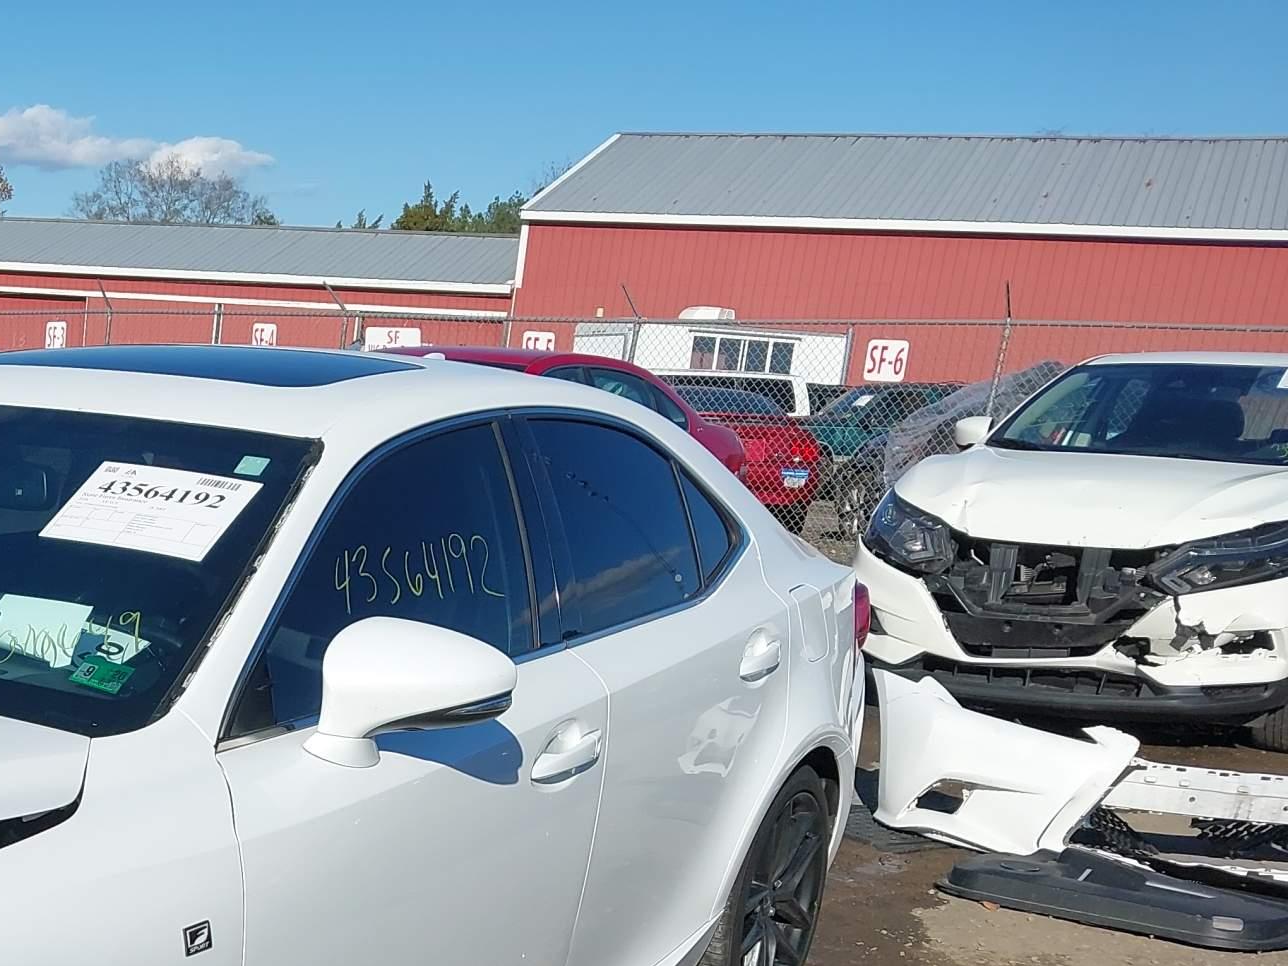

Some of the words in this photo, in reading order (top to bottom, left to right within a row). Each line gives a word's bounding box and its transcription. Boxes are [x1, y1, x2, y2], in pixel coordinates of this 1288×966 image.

[47, 326, 65, 348] SF-3
[254, 328, 274, 346] SF-4
[387, 330, 400, 344] SF
[867, 345, 905, 375] SF-6
[98, 479, 227, 509] 43564192
[334, 533, 505, 615] 43564192
